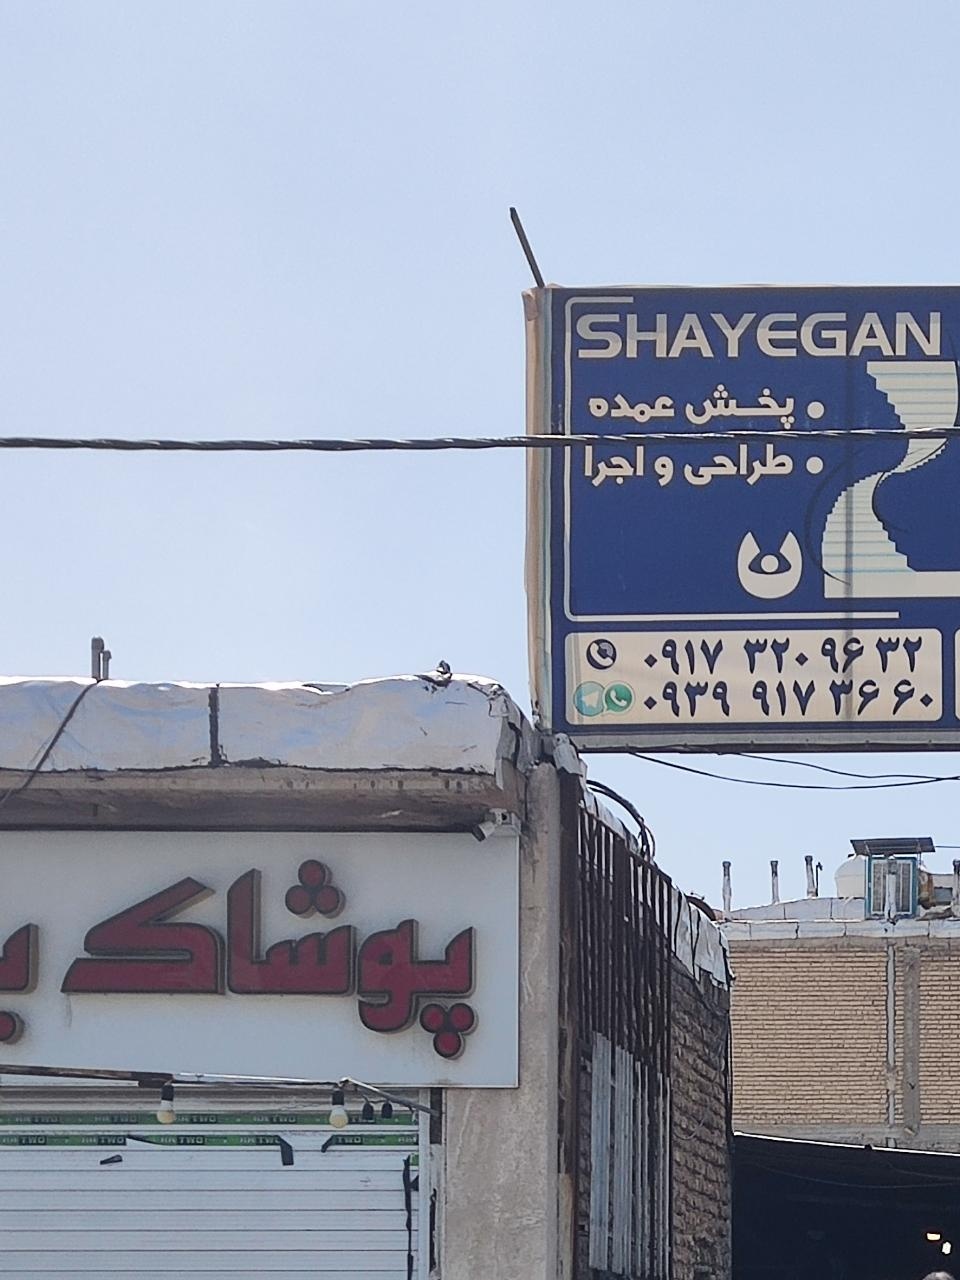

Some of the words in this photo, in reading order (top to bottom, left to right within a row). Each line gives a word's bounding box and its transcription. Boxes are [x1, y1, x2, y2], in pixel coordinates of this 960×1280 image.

[576, 311, 941, 358] SHAYEGAN
[588, 394, 675, 422] عمده
[685, 384, 795, 429] پخش
[584, 444, 644, 486] اجرا
[653, 458, 674, 486] و
[684, 444, 793, 485] طراحی
[60, 858, 479, 1060] پوشاک
